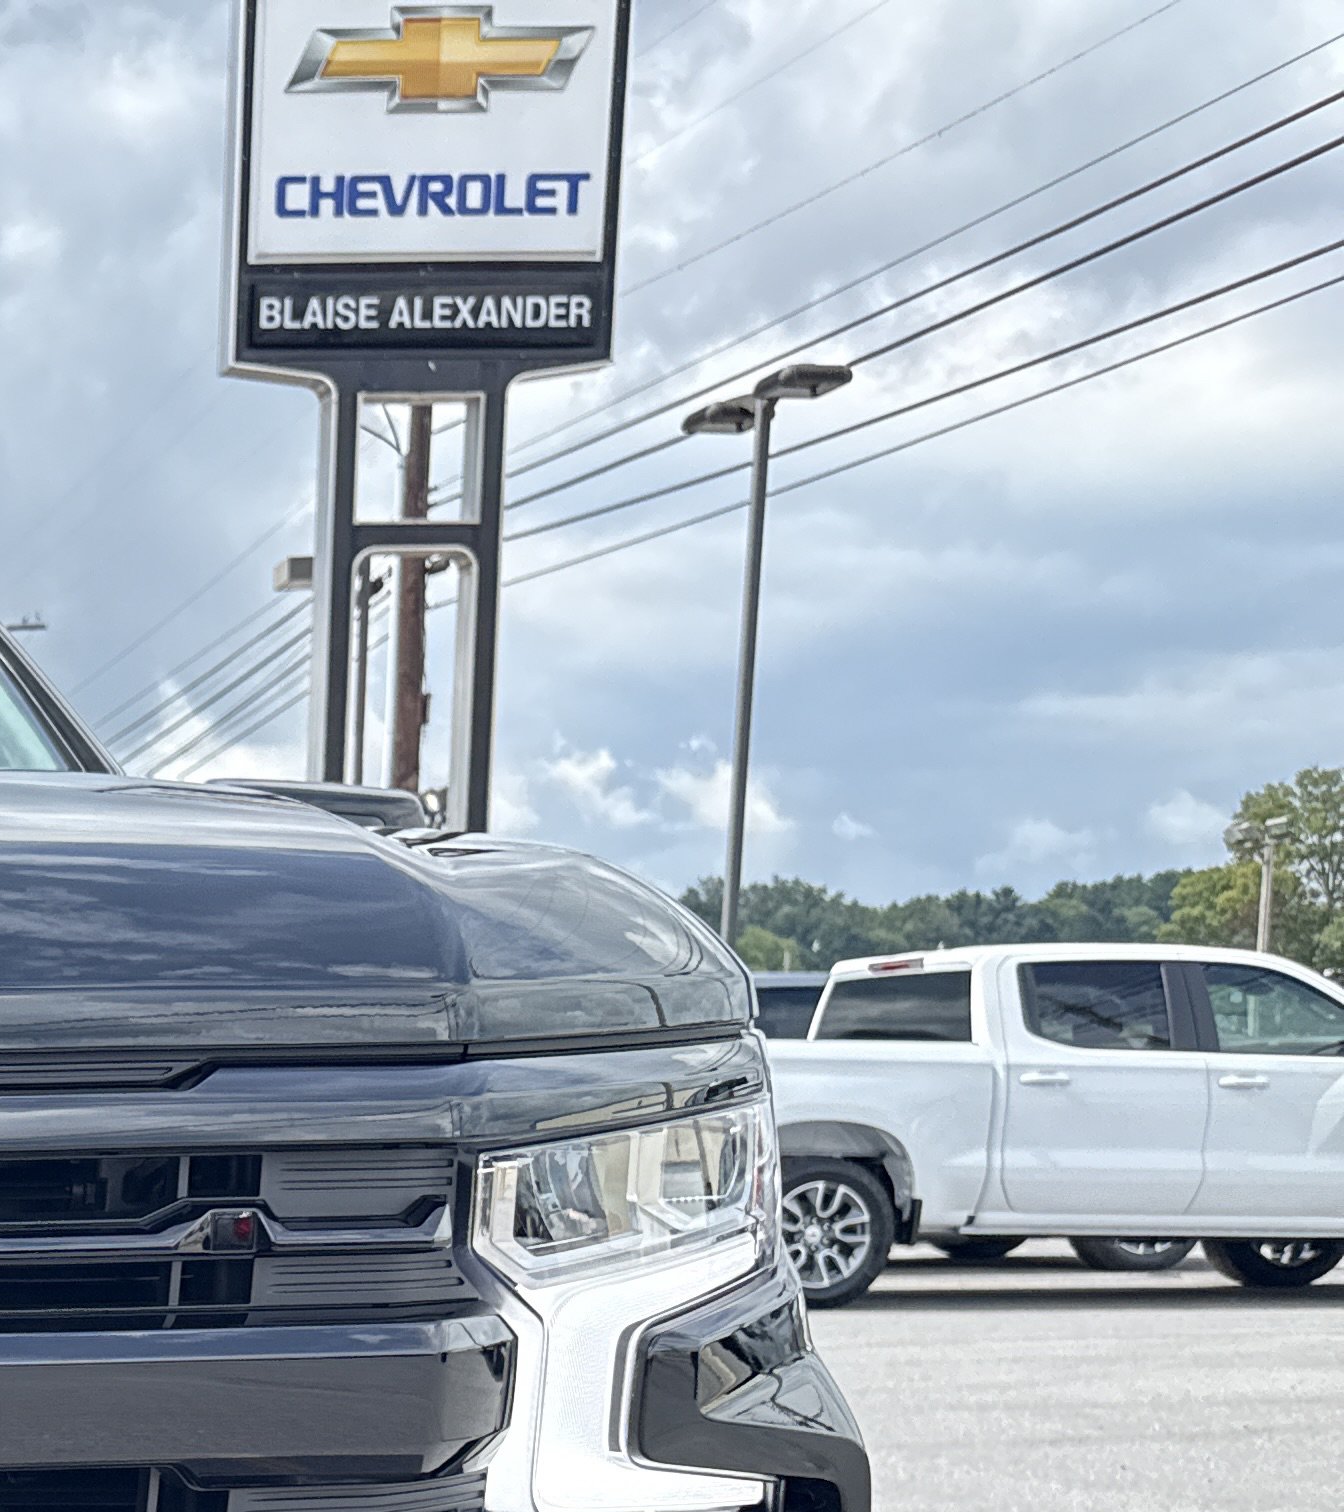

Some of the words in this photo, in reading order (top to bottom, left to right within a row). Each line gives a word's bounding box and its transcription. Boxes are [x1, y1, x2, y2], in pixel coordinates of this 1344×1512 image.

[275, 173, 591, 218] CHEVROLET
[258, 296, 380, 330] BLAISE
[388, 295, 592, 329] ALEXANDER
